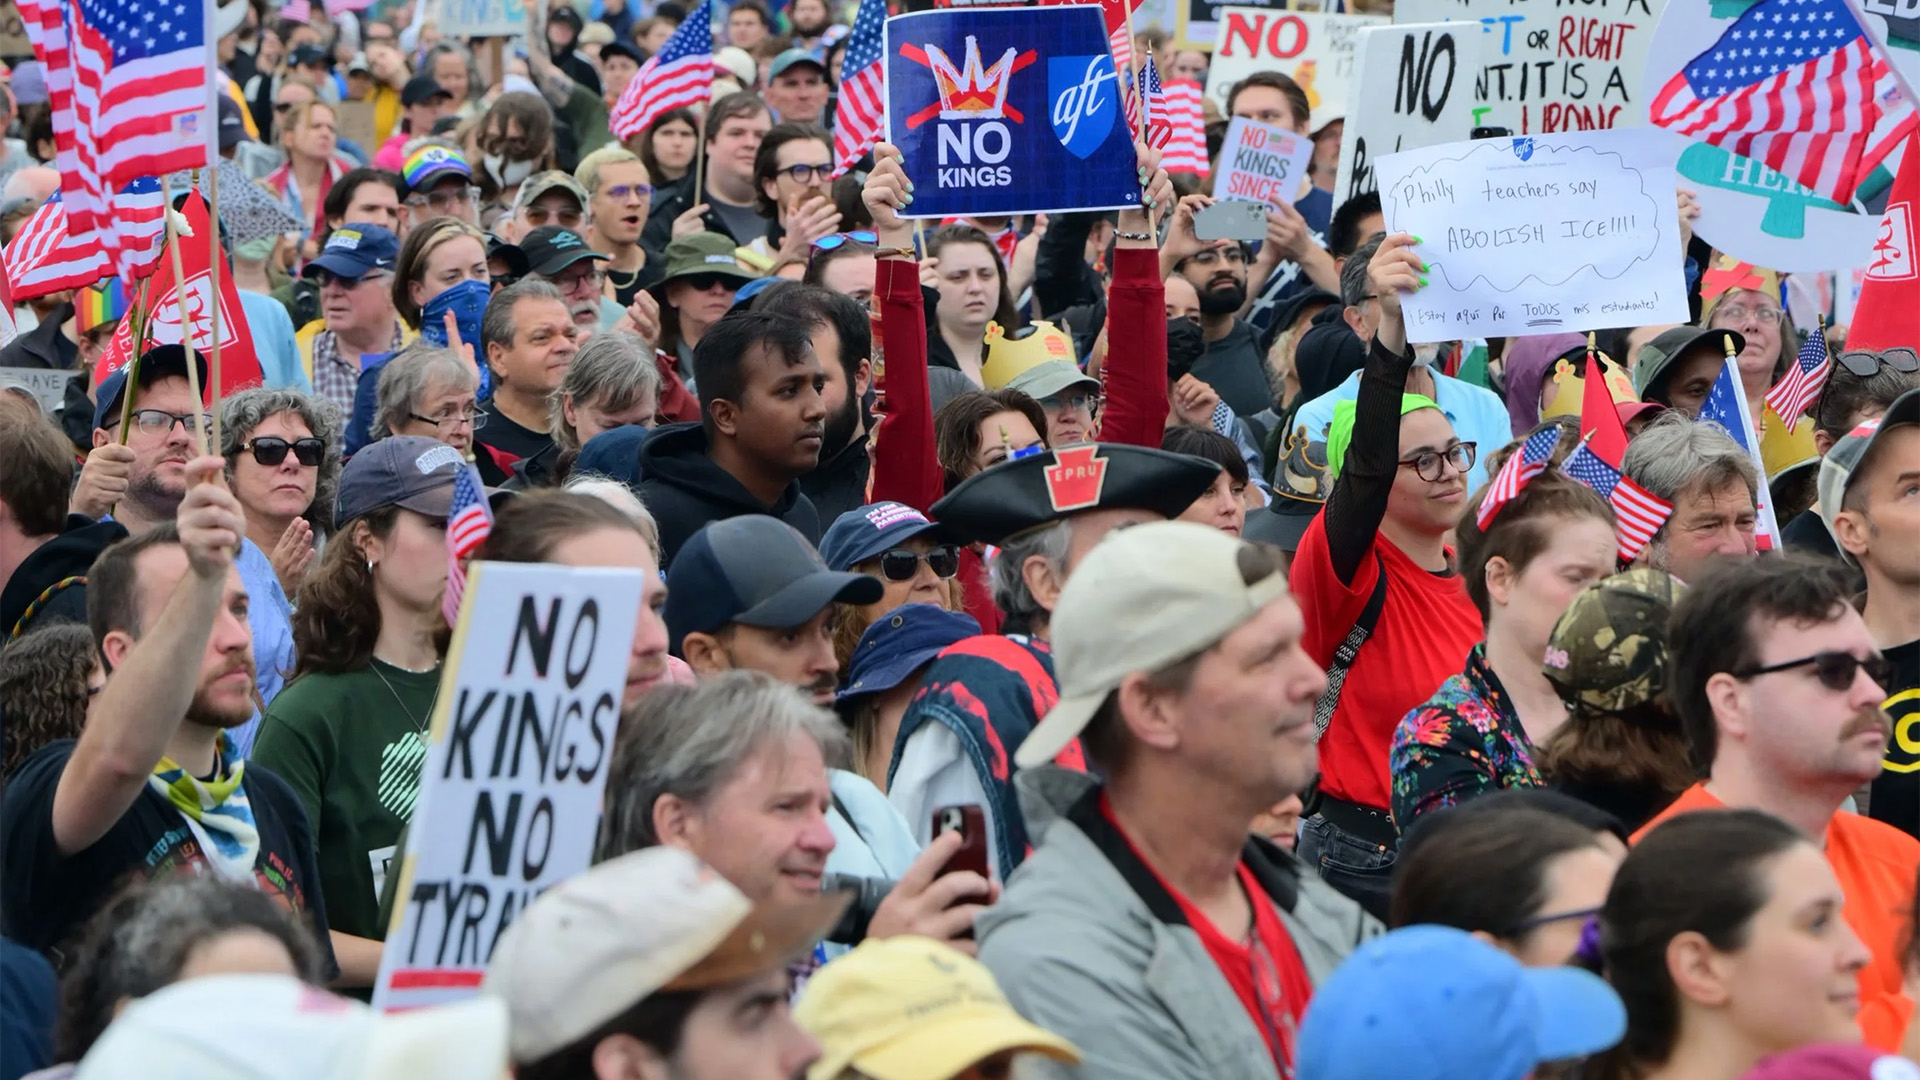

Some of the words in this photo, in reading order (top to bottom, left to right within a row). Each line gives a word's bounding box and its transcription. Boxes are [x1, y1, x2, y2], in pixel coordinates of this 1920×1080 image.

[1220, 13, 1308, 59] NO
[1527, 29, 1549, 50] OR
[1557, 15, 1636, 61] RIGHT
[1394, 30, 1456, 123] NO
[1562, 60, 1589, 99] IS
[1603, 65, 1631, 102] A
[1053, 54, 1117, 146] aft
[937, 121, 1012, 165] NO
[1240, 124, 1267, 149] NO
[938, 166, 1012, 188] KINGS
[1233, 147, 1290, 180] KINGS
[1227, 171, 1283, 202] SINCE
[1403, 178, 1455, 208] Philly
[1481, 180, 1560, 202] teachers
[1568, 179, 1597, 200] say
[1448, 224, 1545, 252] ABOLISH
[1055, 464, 1097, 482] EPRU
[506, 594, 598, 690] NO
[442, 687, 614, 785] KINGS
[462, 790, 555, 882] NO
[407, 880, 545, 966] TYRA
